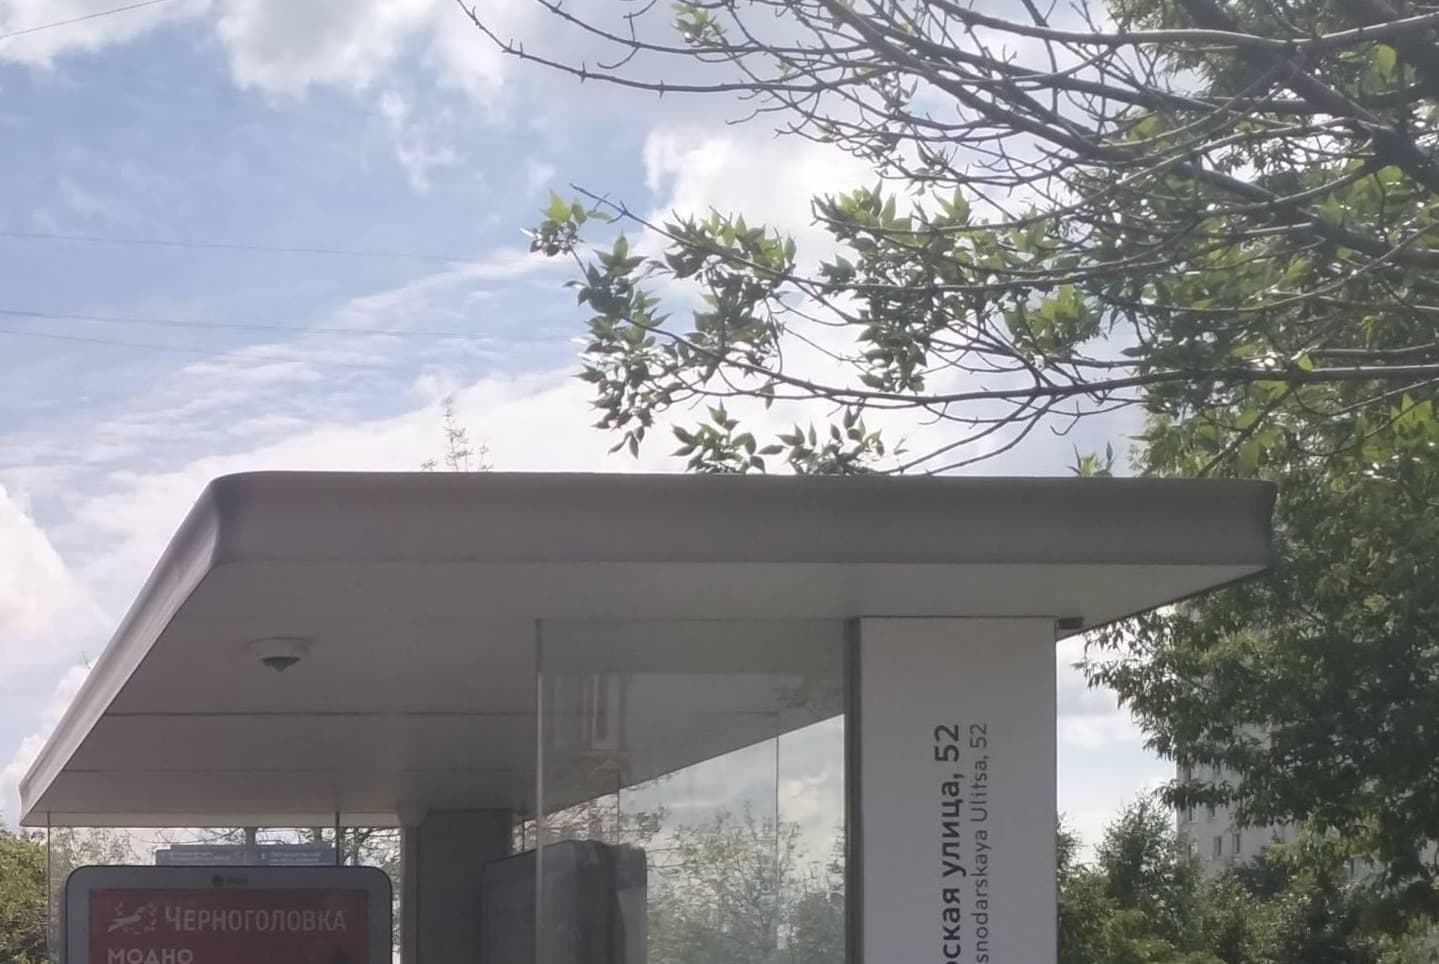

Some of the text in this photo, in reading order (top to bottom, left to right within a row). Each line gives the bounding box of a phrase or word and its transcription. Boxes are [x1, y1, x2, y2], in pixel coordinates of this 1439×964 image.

[934, 724, 960, 762] 52
[969, 723, 987, 749] 52
[969, 755, 990, 822] Ulitsa,
[941, 773, 967, 878] улица,
[164, 905, 347, 932] ЧЕРНОГОЛОВКА
